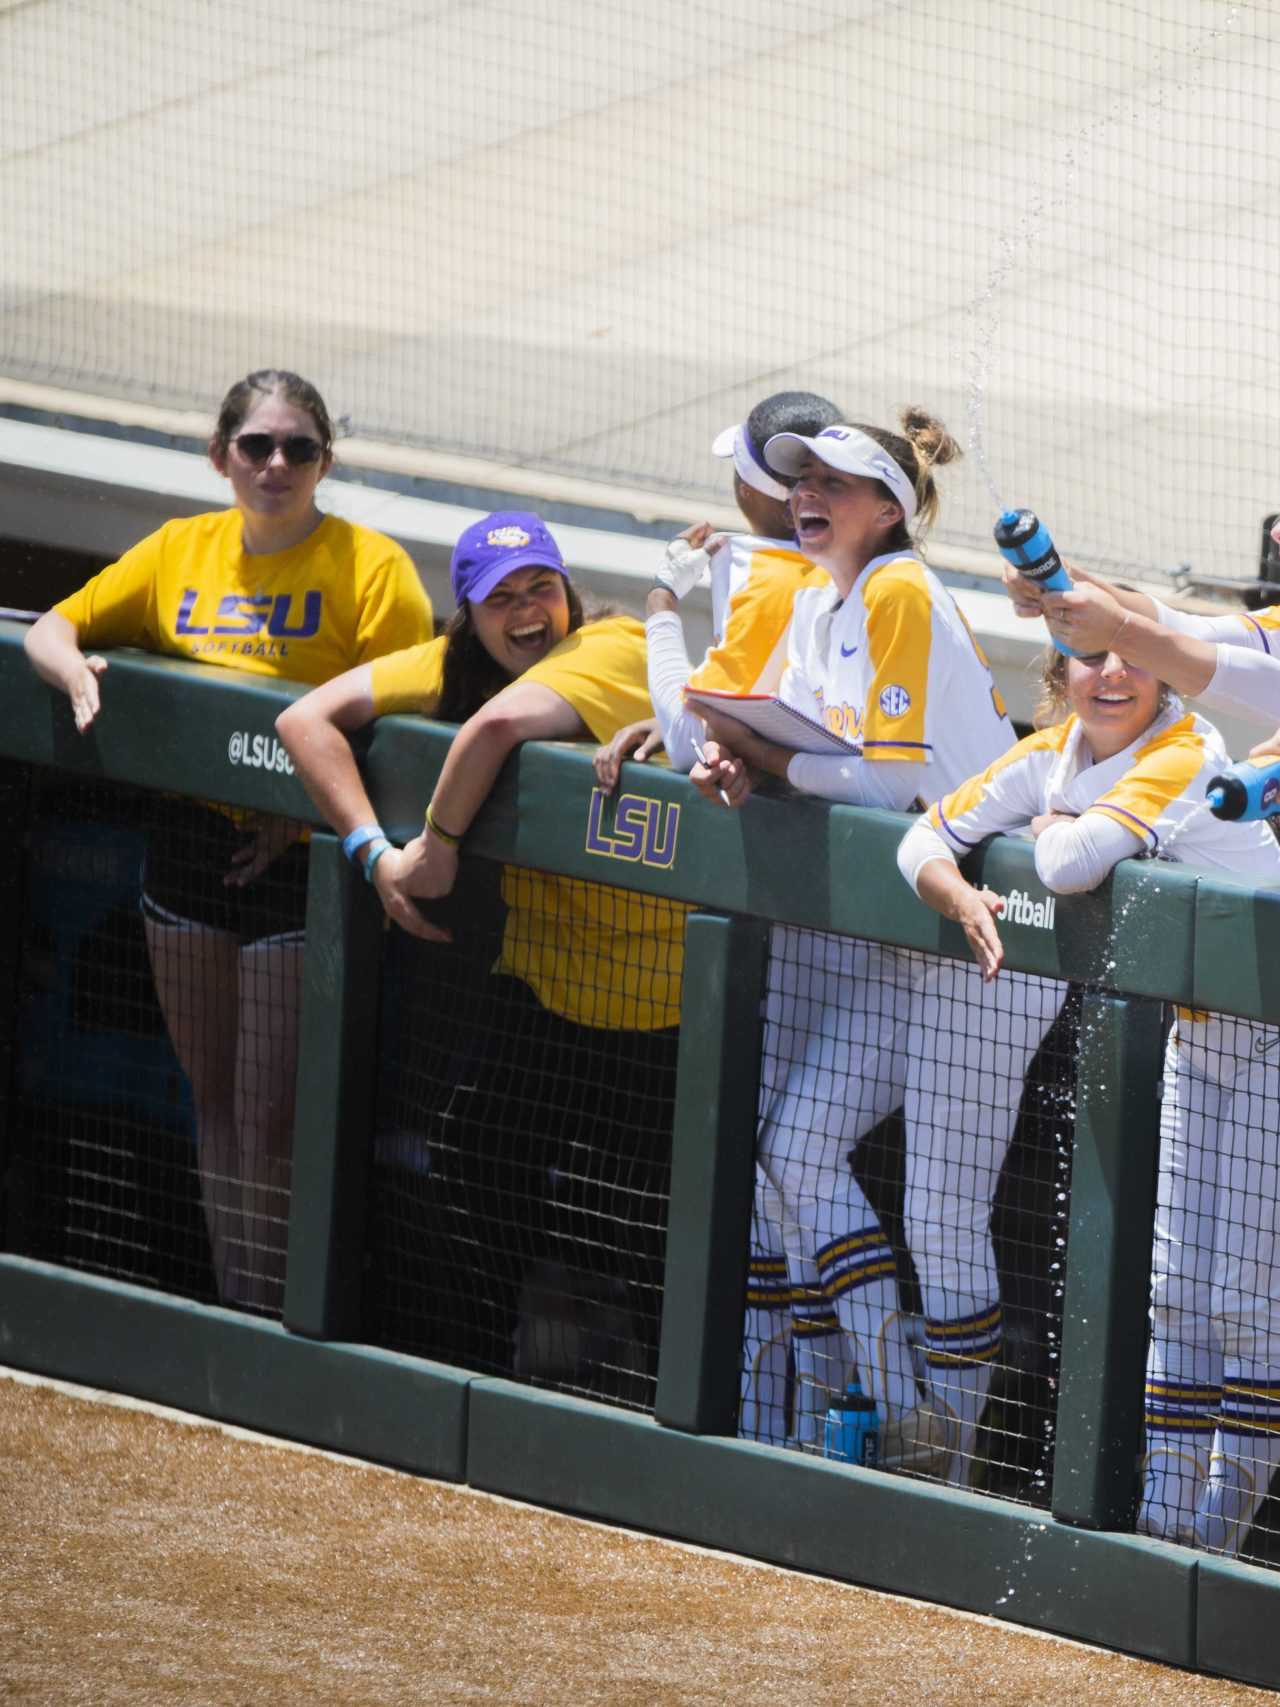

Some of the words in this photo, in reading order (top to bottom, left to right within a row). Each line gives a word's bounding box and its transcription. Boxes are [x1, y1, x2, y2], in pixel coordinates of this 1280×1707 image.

[175, 588, 322, 638] LSU
[191, 638, 289, 657] SOFTBALL
[880, 684, 911, 717] SEC
[585, 786, 681, 869] LSU
